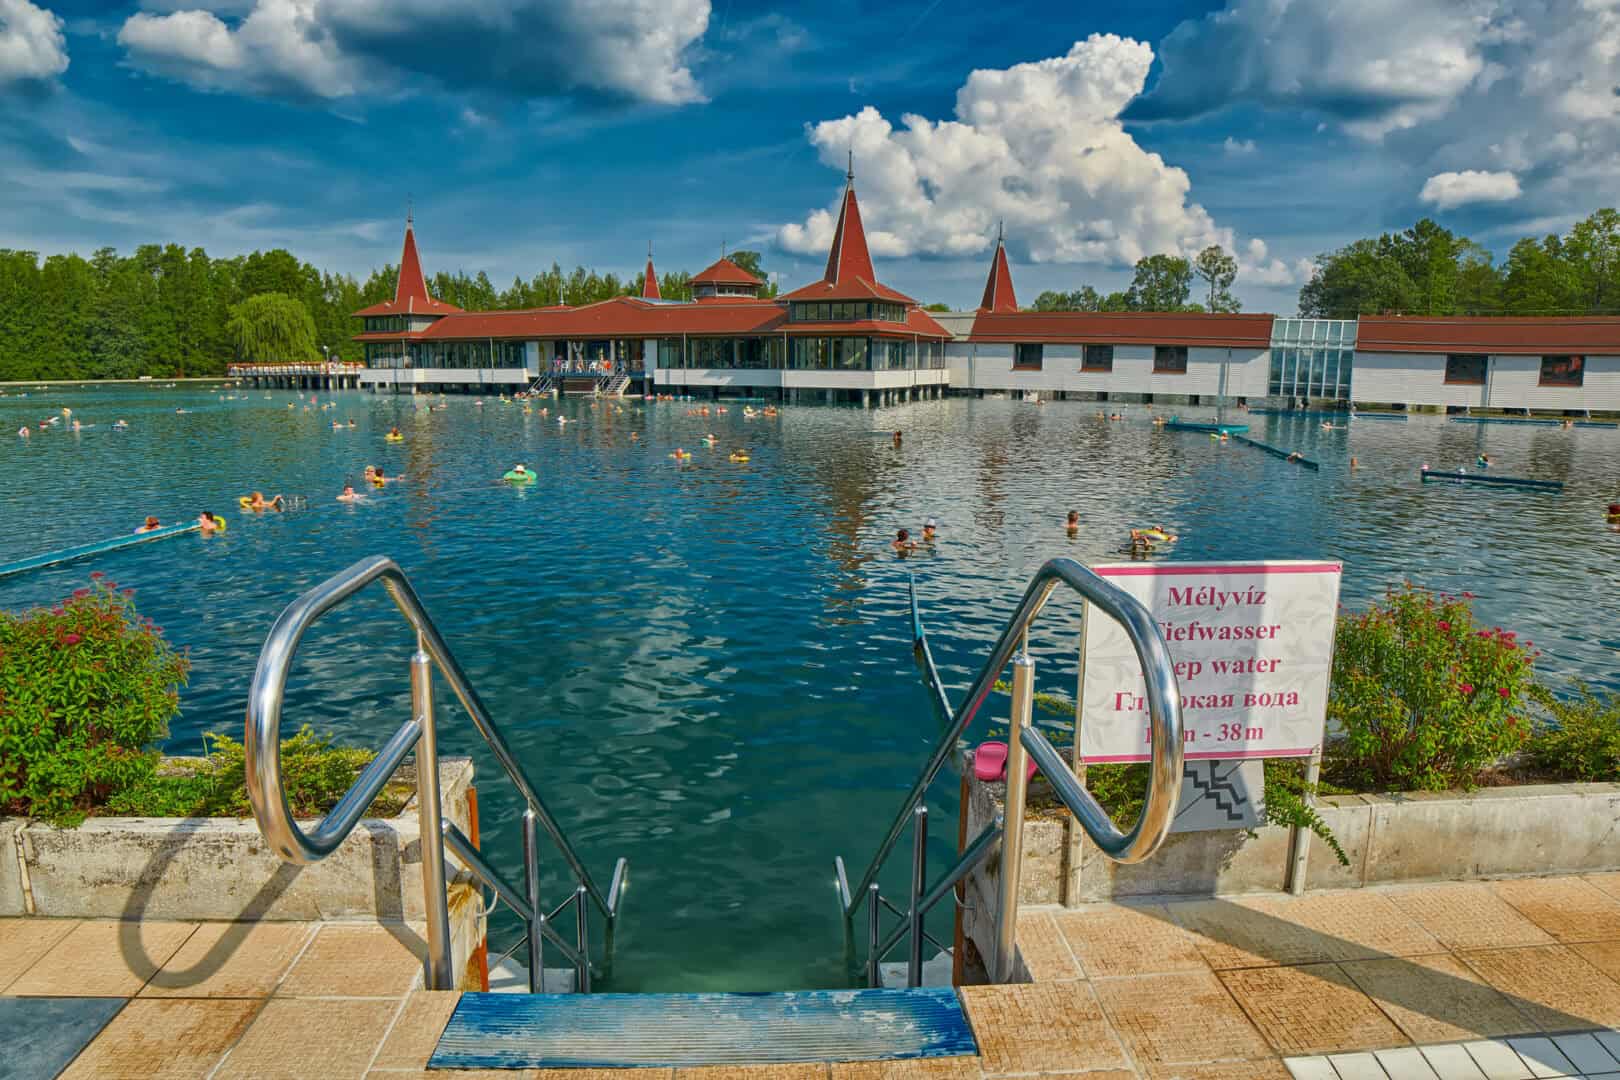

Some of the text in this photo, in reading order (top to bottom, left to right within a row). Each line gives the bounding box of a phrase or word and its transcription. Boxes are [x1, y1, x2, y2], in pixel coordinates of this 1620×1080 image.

[1168, 585, 1266, 611] Mélyvíz
[1138, 656, 1281, 681] ep water
[1114, 690, 1299, 716] Глкая вода
[1217, 723, 1264, 741] 38m
